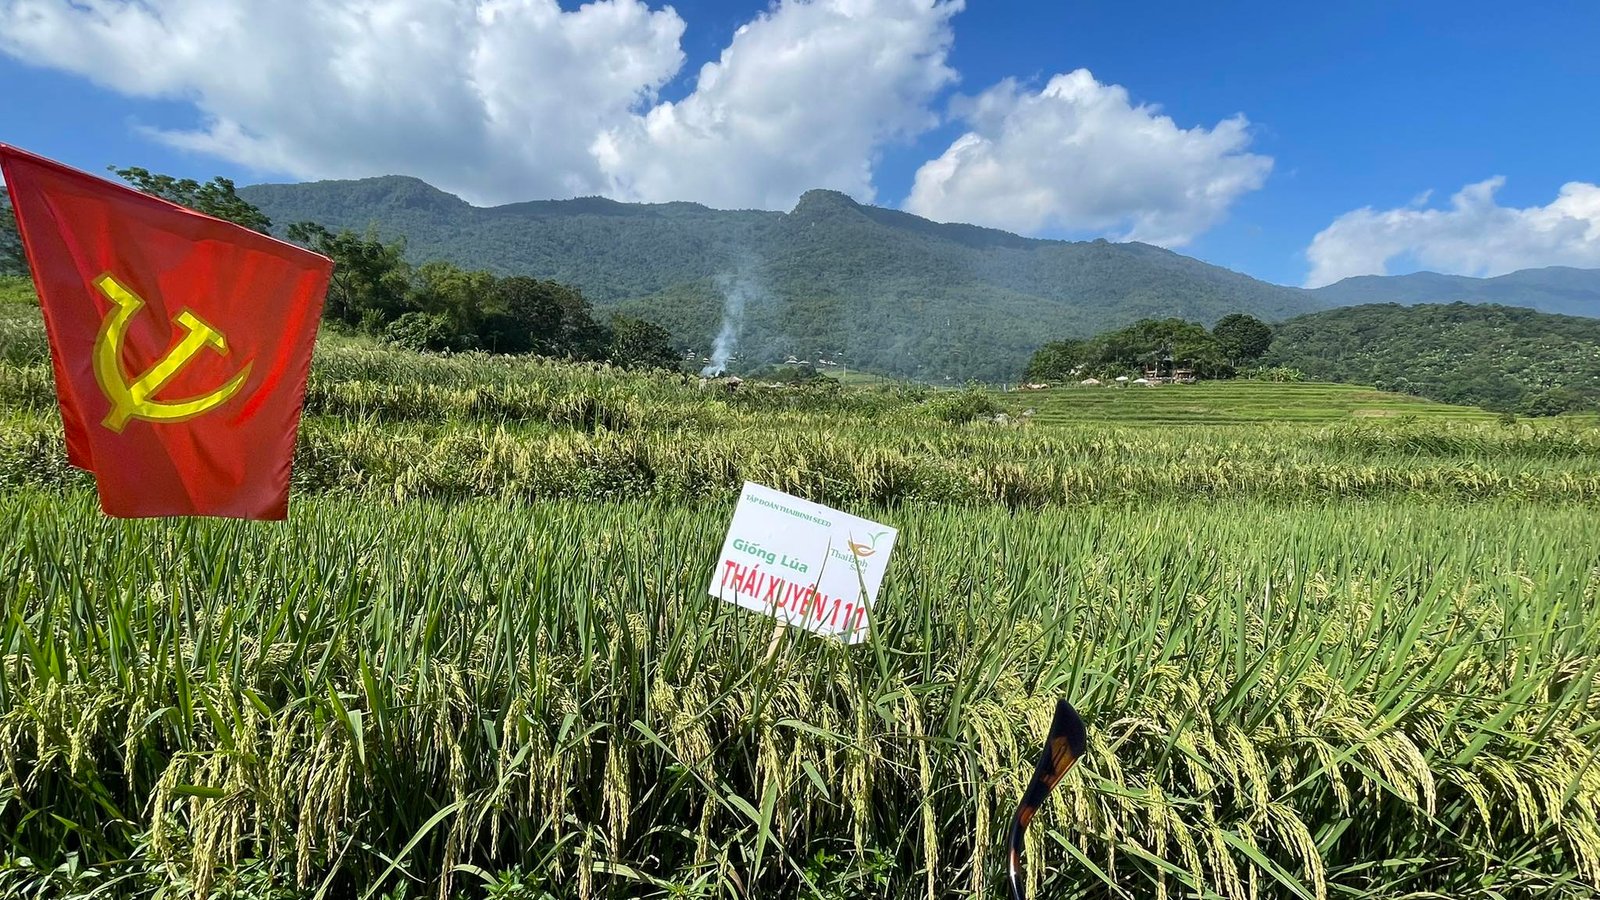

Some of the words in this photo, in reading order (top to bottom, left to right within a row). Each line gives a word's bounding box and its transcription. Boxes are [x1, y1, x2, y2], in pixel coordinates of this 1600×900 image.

[746, 494, 759, 503] TẬP
[779, 506, 813, 521] THAIBINH
[813, 516, 832, 528] SEED
[732, 538, 777, 565] Giống
[780, 554, 809, 574] Lúa
[830, 548, 868, 568] ThaiBnh
[722, 560, 765, 599] THÁI
[762, 575, 829, 622] XUYÊN
[830, 598, 865, 633] 111
